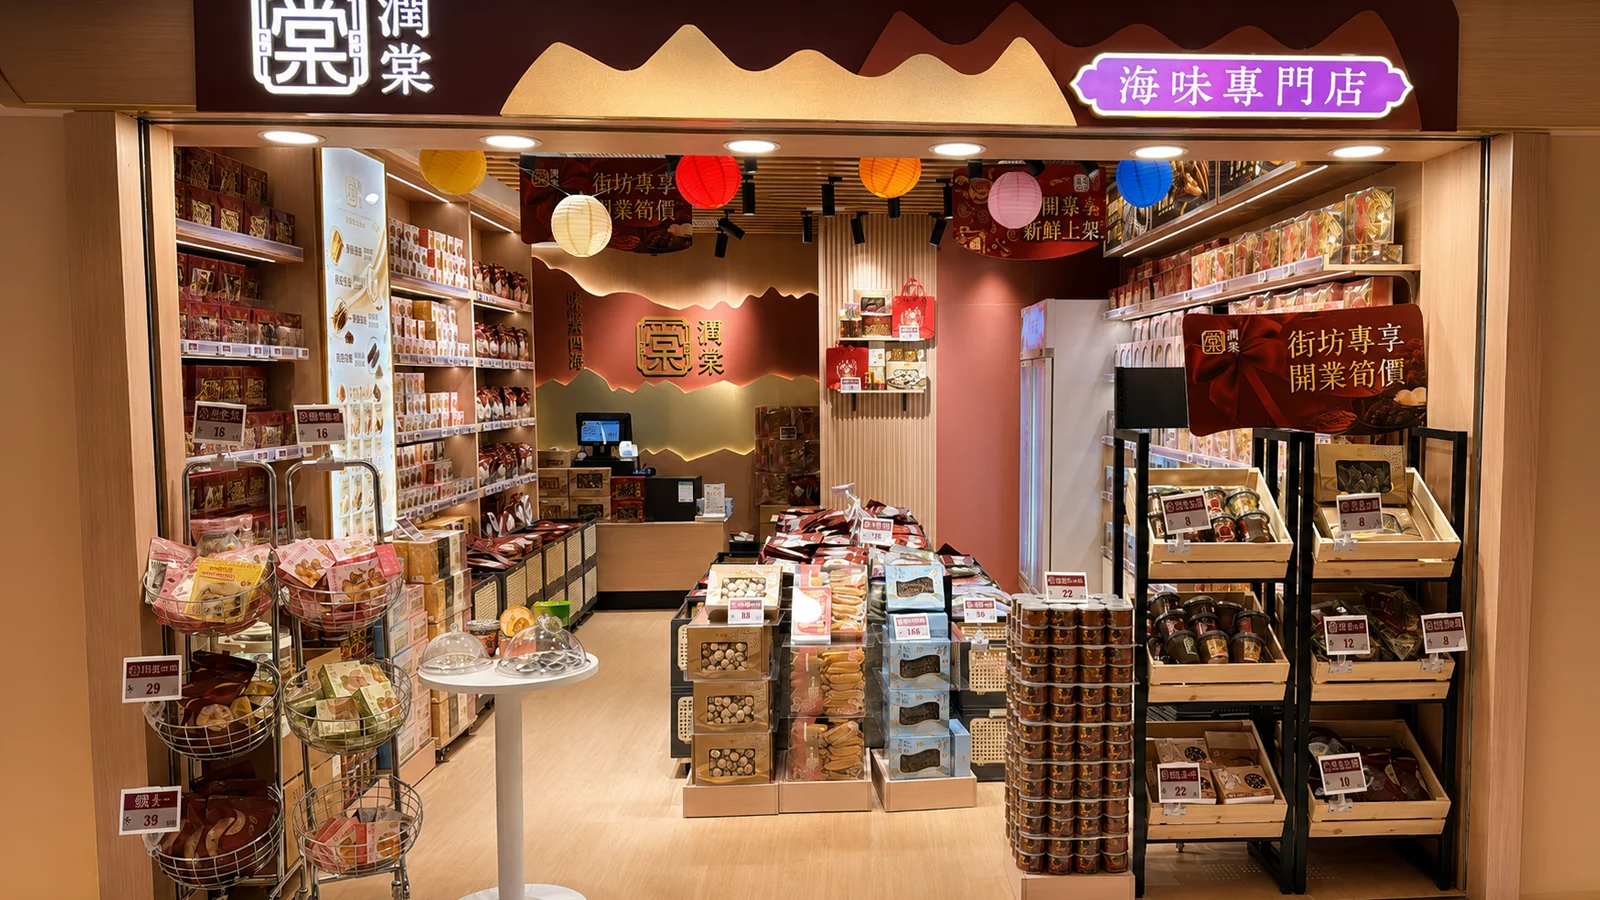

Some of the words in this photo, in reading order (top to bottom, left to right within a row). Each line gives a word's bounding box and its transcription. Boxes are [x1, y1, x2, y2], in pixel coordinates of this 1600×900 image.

[271, 0, 349, 85] 棠
[378, 0, 436, 96] 潤棠
[1118, 65, 1367, 107] 海味專門店
[592, 172, 676, 196] 街坊專享
[1024, 220, 1100, 241] 新鮮上架
[645, 321, 684, 372] 棠
[1287, 322, 1405, 359] 街坊專享
[696, 319, 725, 376] 潤棠
[1289, 357, 1406, 393] 開業筍價
[315, 427, 328, 439] 16
[1184, 516, 1191, 526] 8
[1358, 516, 1365, 527] 8
[1062, 589, 1073, 598] 22
[1343, 638, 1354, 648] 12
[1443, 636, 1449, 645] 8
[146, 682, 161, 695] 29
[1340, 776, 1350, 787] 10
[1174, 786, 1187, 797] 22
[144, 814, 158, 827] 39
